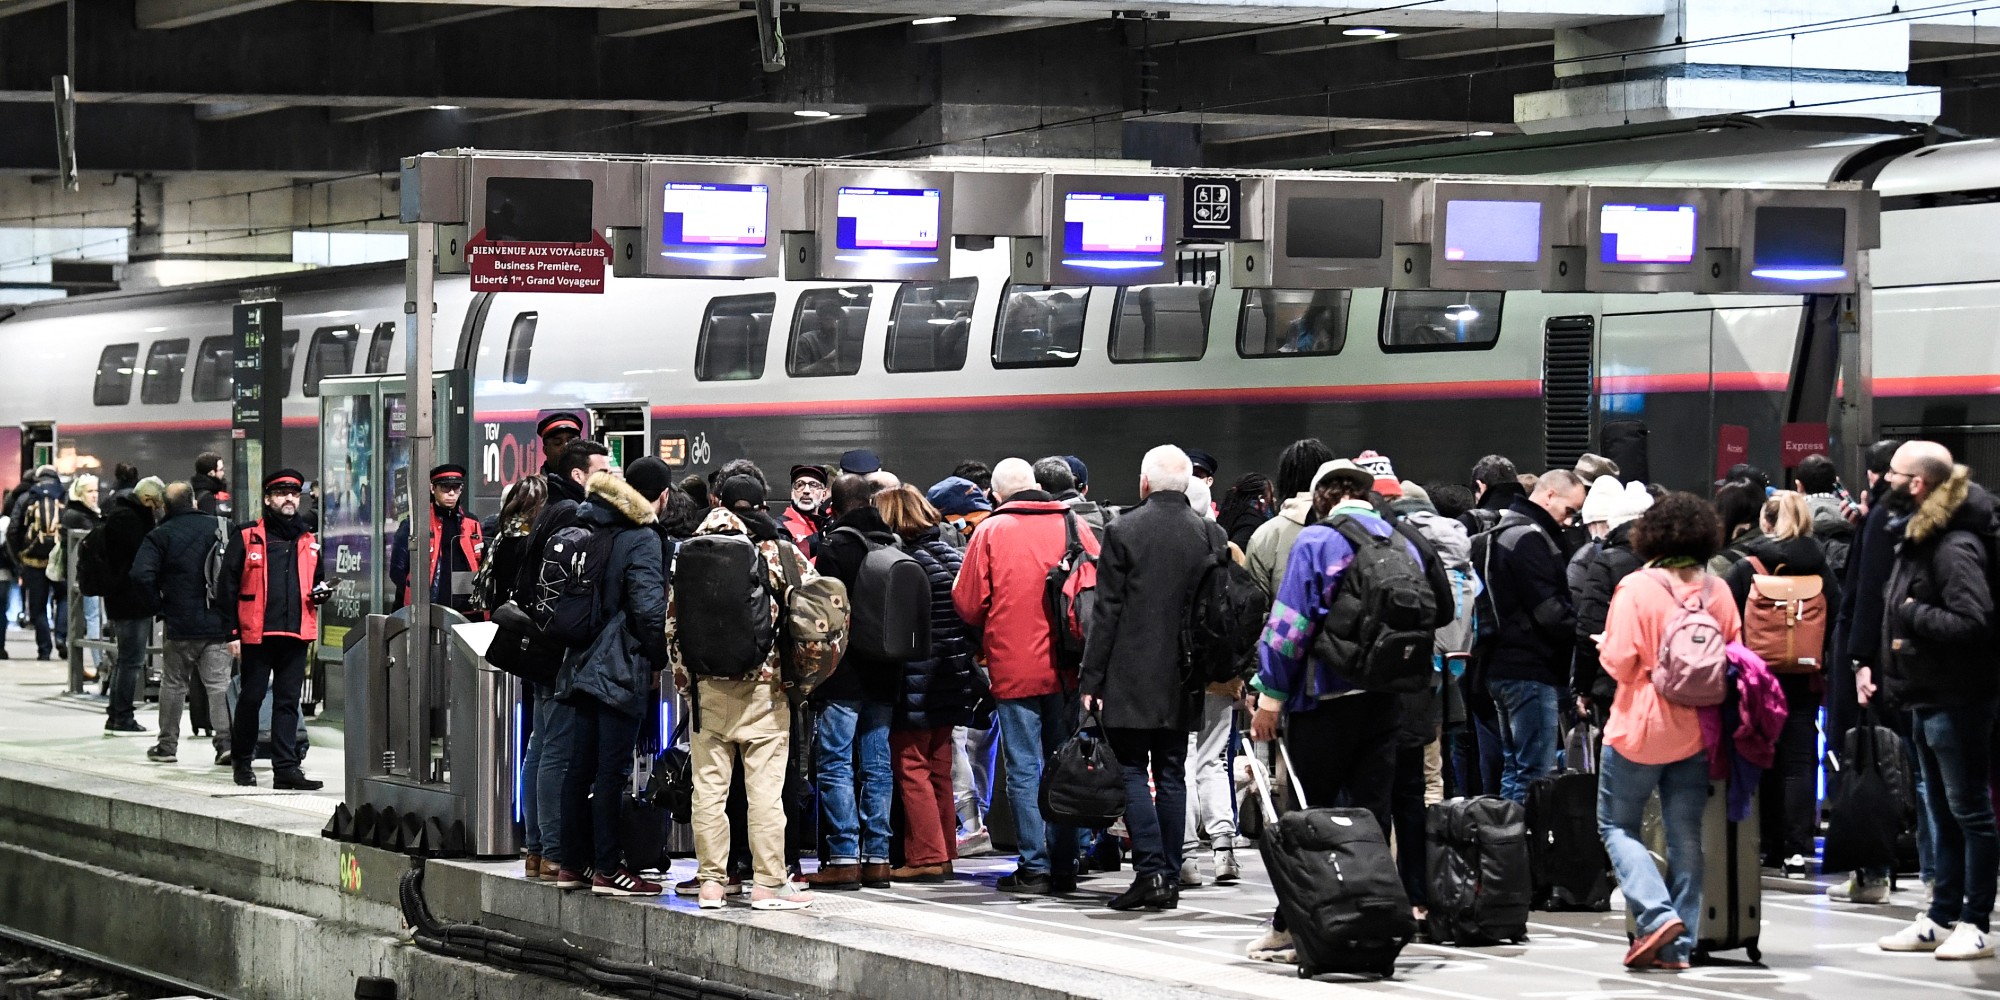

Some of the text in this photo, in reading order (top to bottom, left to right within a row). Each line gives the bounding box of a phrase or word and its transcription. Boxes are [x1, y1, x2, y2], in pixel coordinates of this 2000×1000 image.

[473, 247, 605, 257] BIENVENUE AUX VOYAGEURS
[495, 261, 582, 273] Business Première,
[475, 275, 508, 284] Liberté
[527, 276, 555, 285] Grand
[557, 276, 600, 287] Voyageur
[484, 423, 500, 440] TGV
[1785, 441, 1824, 452] Express
